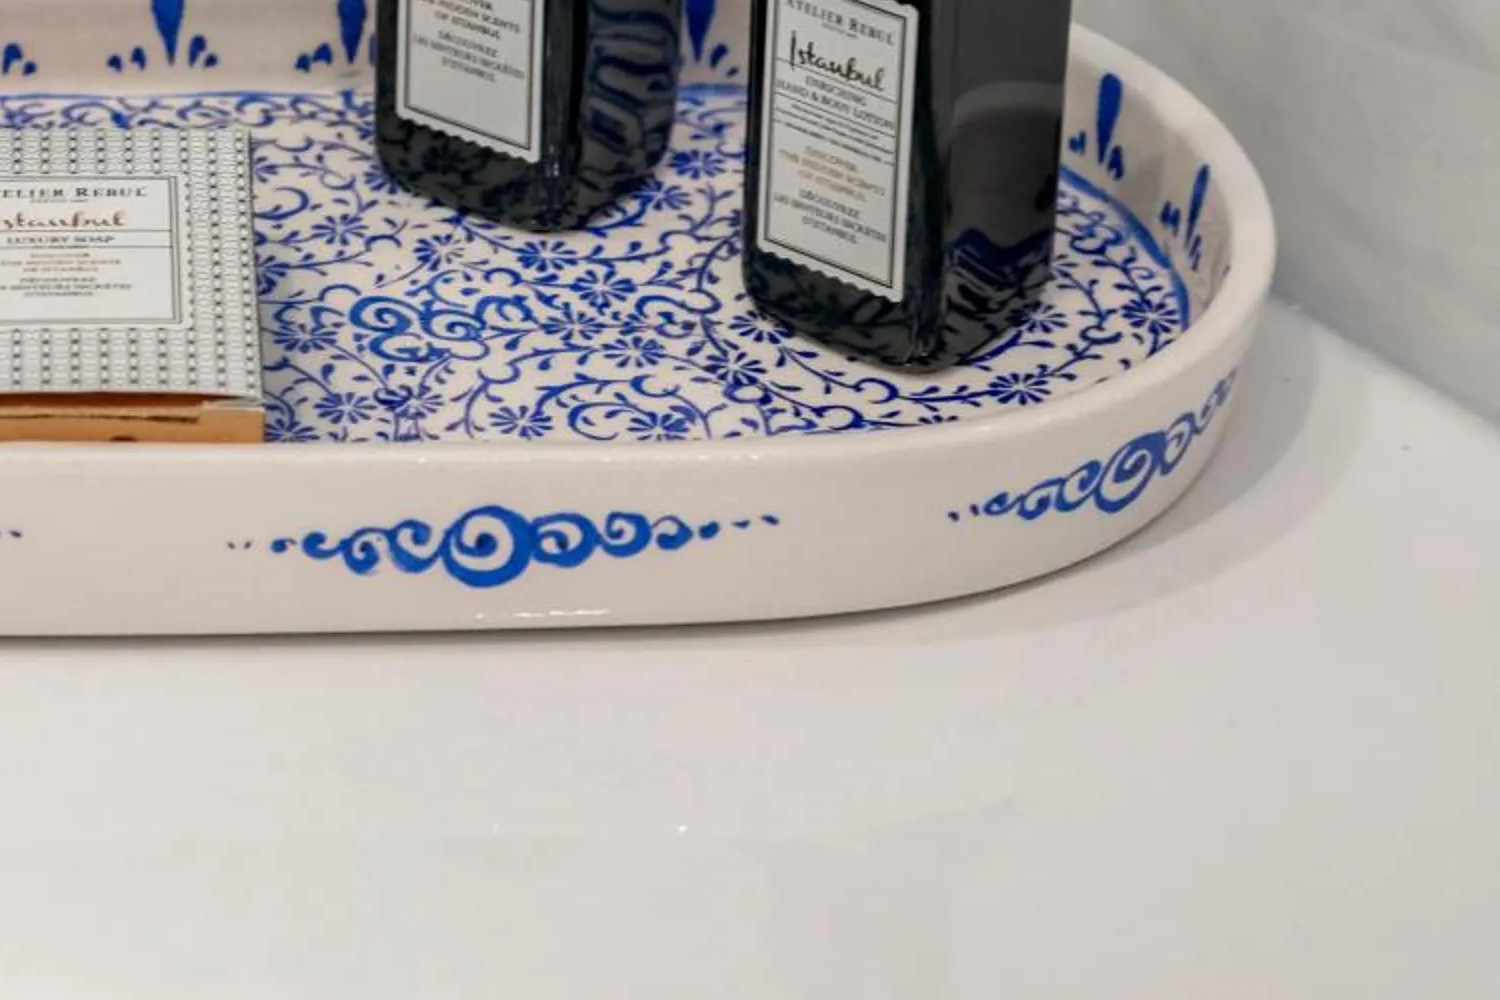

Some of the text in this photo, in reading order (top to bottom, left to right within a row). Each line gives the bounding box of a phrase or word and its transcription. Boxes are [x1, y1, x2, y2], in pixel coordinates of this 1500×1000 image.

[848, 18, 895, 46] REBUL
[75, 186, 147, 198] REBUL
[7, 234, 116, 244] LUXURY SOAP
